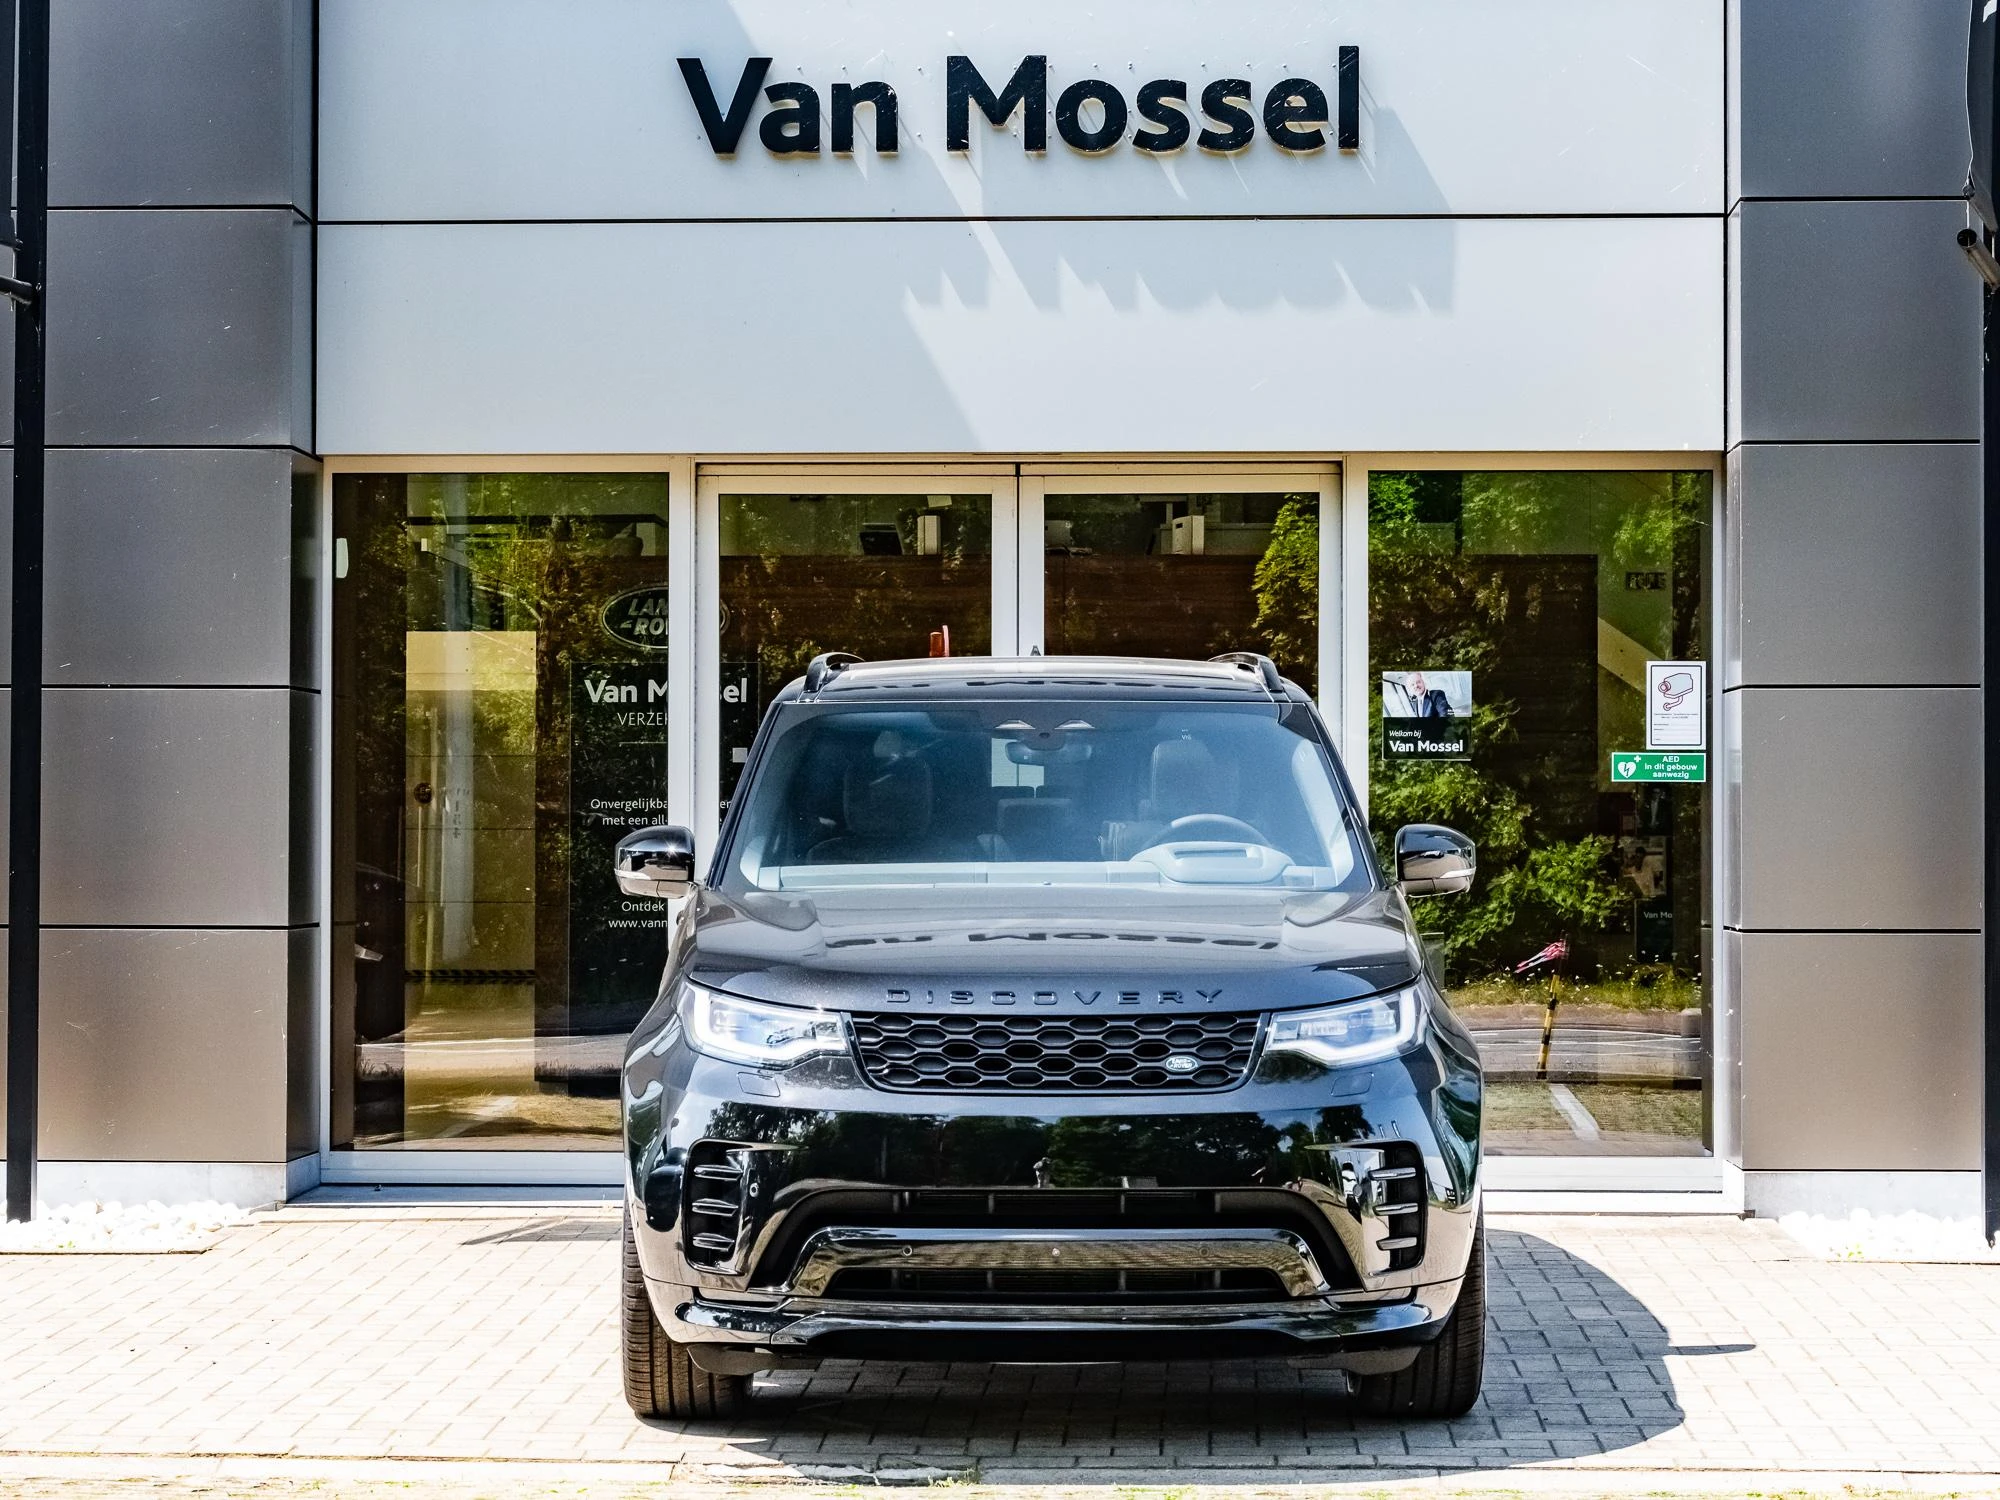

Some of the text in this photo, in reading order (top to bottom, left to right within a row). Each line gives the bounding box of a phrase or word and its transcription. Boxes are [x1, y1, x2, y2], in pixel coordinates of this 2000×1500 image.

[676, 46, 1360, 155] Van Mossel
[628, 598, 669, 616] LAN
[584, 679, 637, 703] Van
[1389, 739, 1464, 752] Van Mossel
[1662, 755, 1680, 763] AED
[1666, 763, 1698, 771] gebouw
[1652, 770, 1690, 780] aanwezig
[602, 816, 625, 826] met
[628, 817, 648, 826] een
[621, 900, 665, 912] Ontdek
[1643, 911, 1659, 919] Van
[886, 988, 1223, 1006] DISCOVERY
